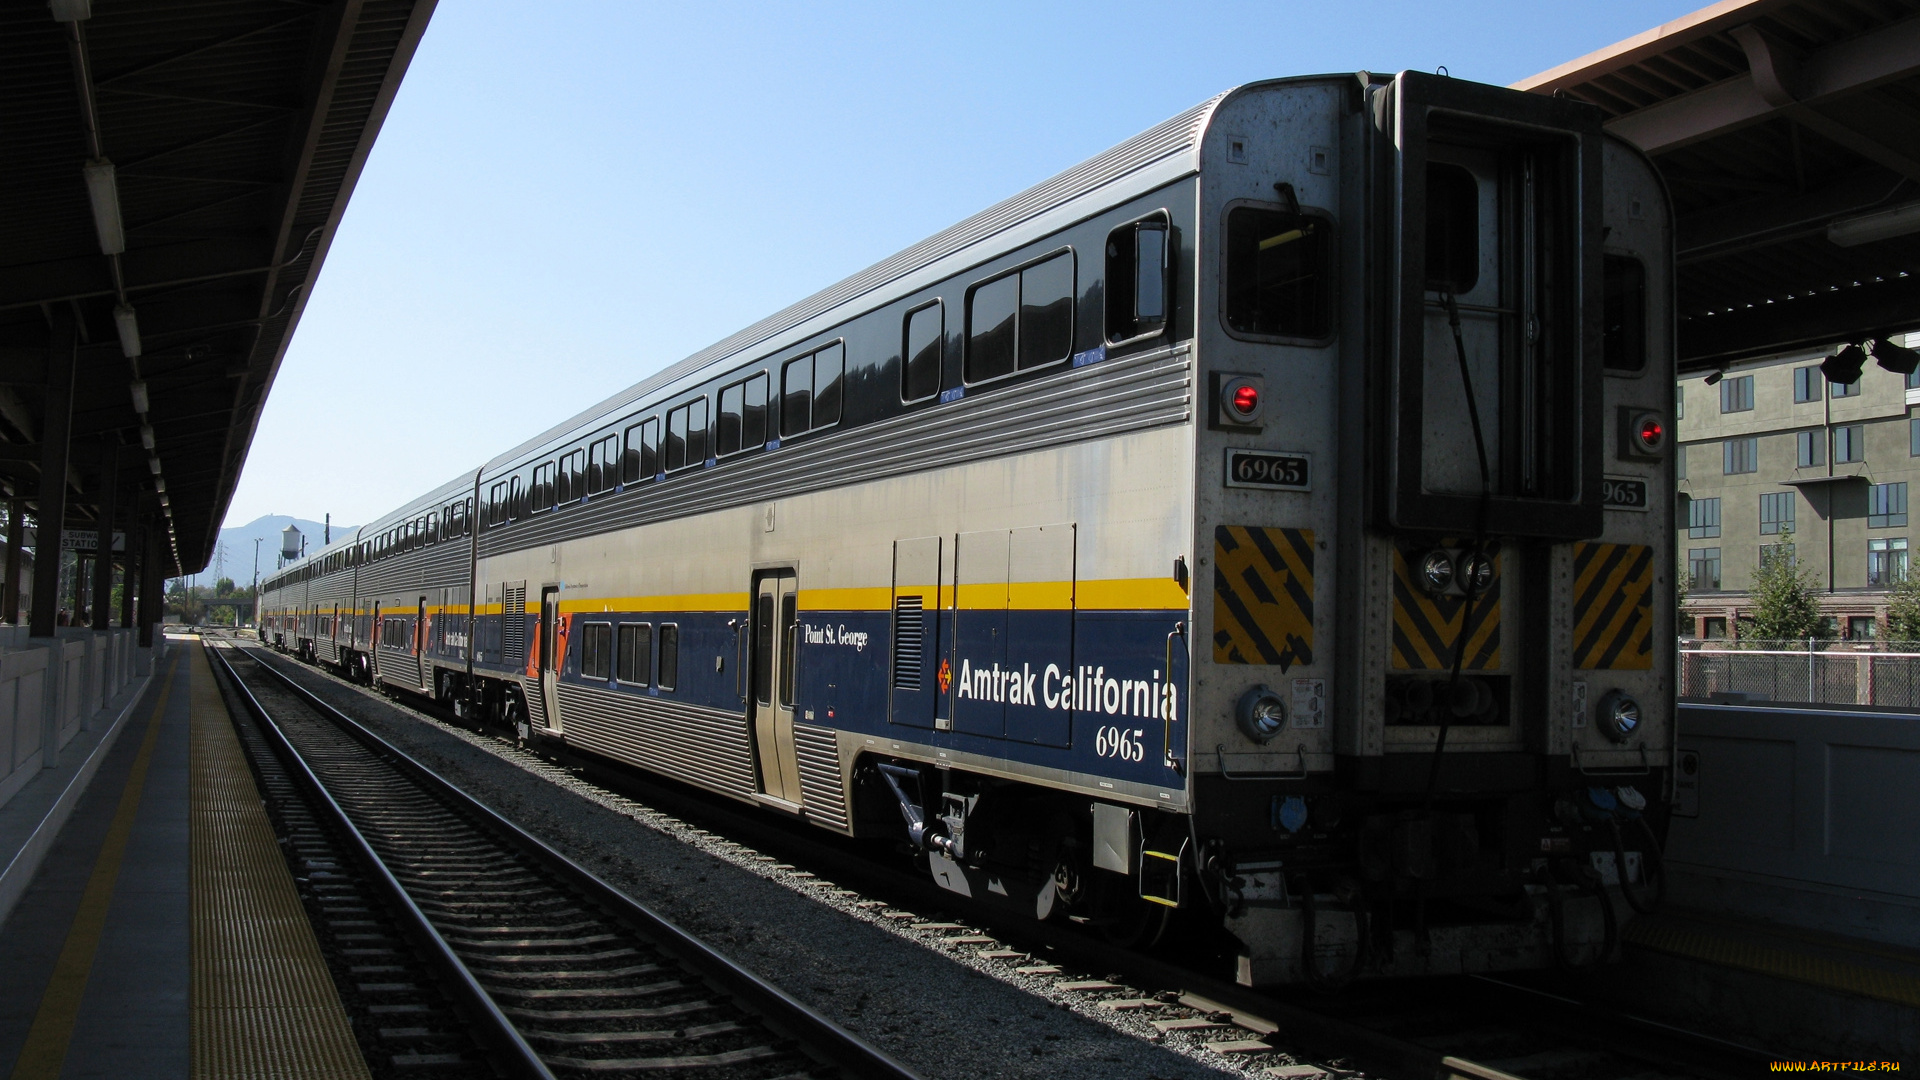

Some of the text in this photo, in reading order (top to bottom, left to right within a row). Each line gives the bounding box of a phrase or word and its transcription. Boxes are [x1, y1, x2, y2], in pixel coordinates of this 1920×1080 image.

[1238, 459, 1300, 482] 6965
[1603, 481, 1638, 504] 965
[62, 539, 98, 548] STATIO
[68, 531, 98, 539] SUBWA
[805, 624, 868, 652] Point St. George
[958, 659, 1178, 721] Amtrak California
[1095, 725, 1144, 762] 6965
